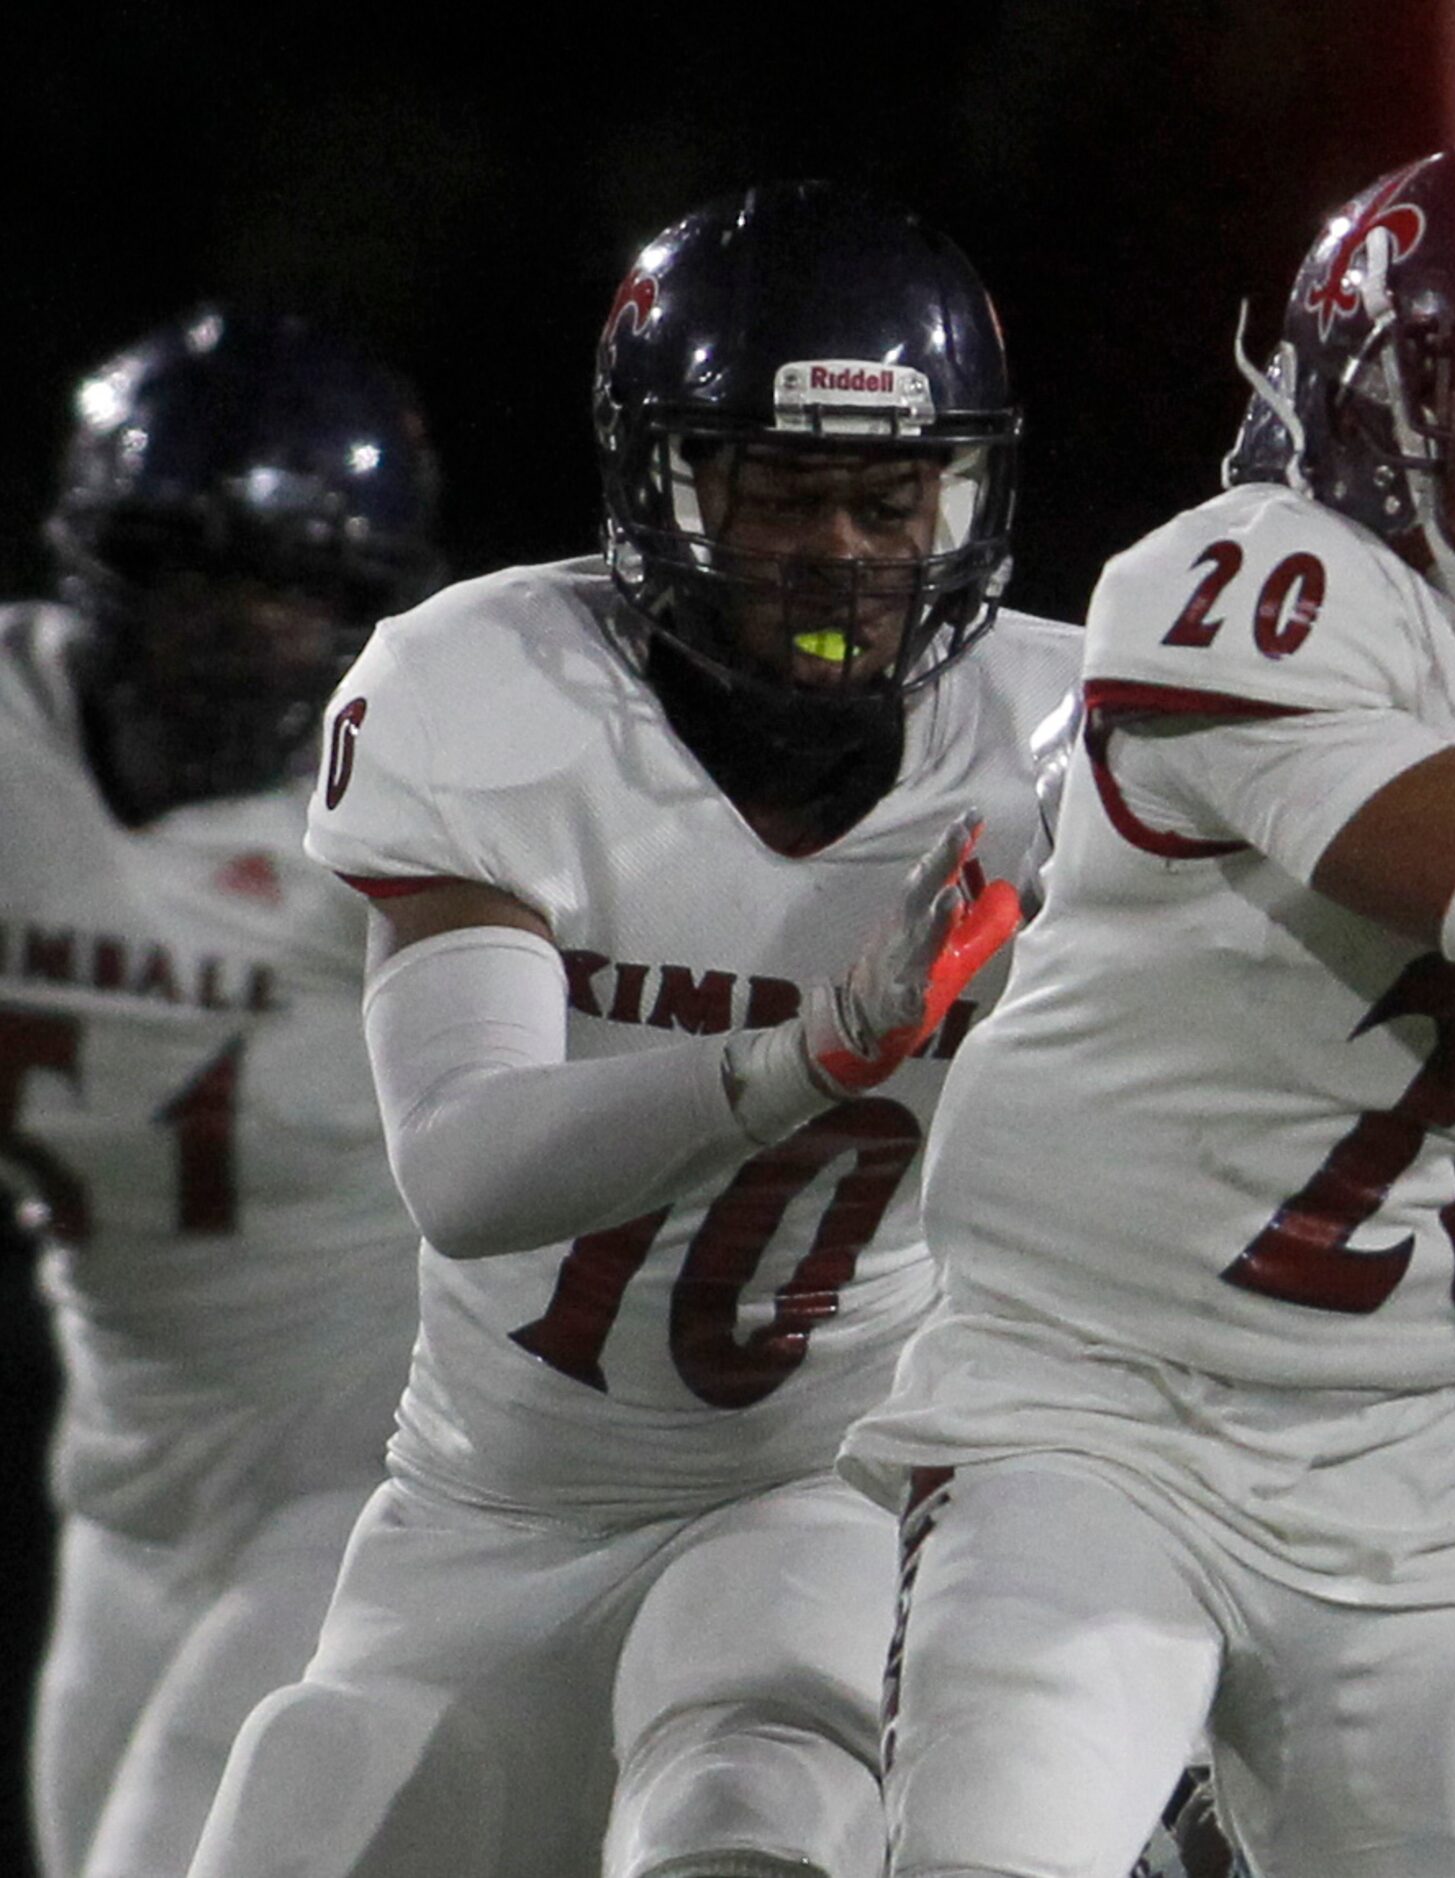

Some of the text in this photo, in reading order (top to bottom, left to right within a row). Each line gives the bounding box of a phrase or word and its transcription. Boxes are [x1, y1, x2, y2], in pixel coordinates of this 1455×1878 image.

[811, 366, 893, 392] Riddell
[1160, 539, 1327, 661] 20
[507, 1096, 924, 1410] 10
